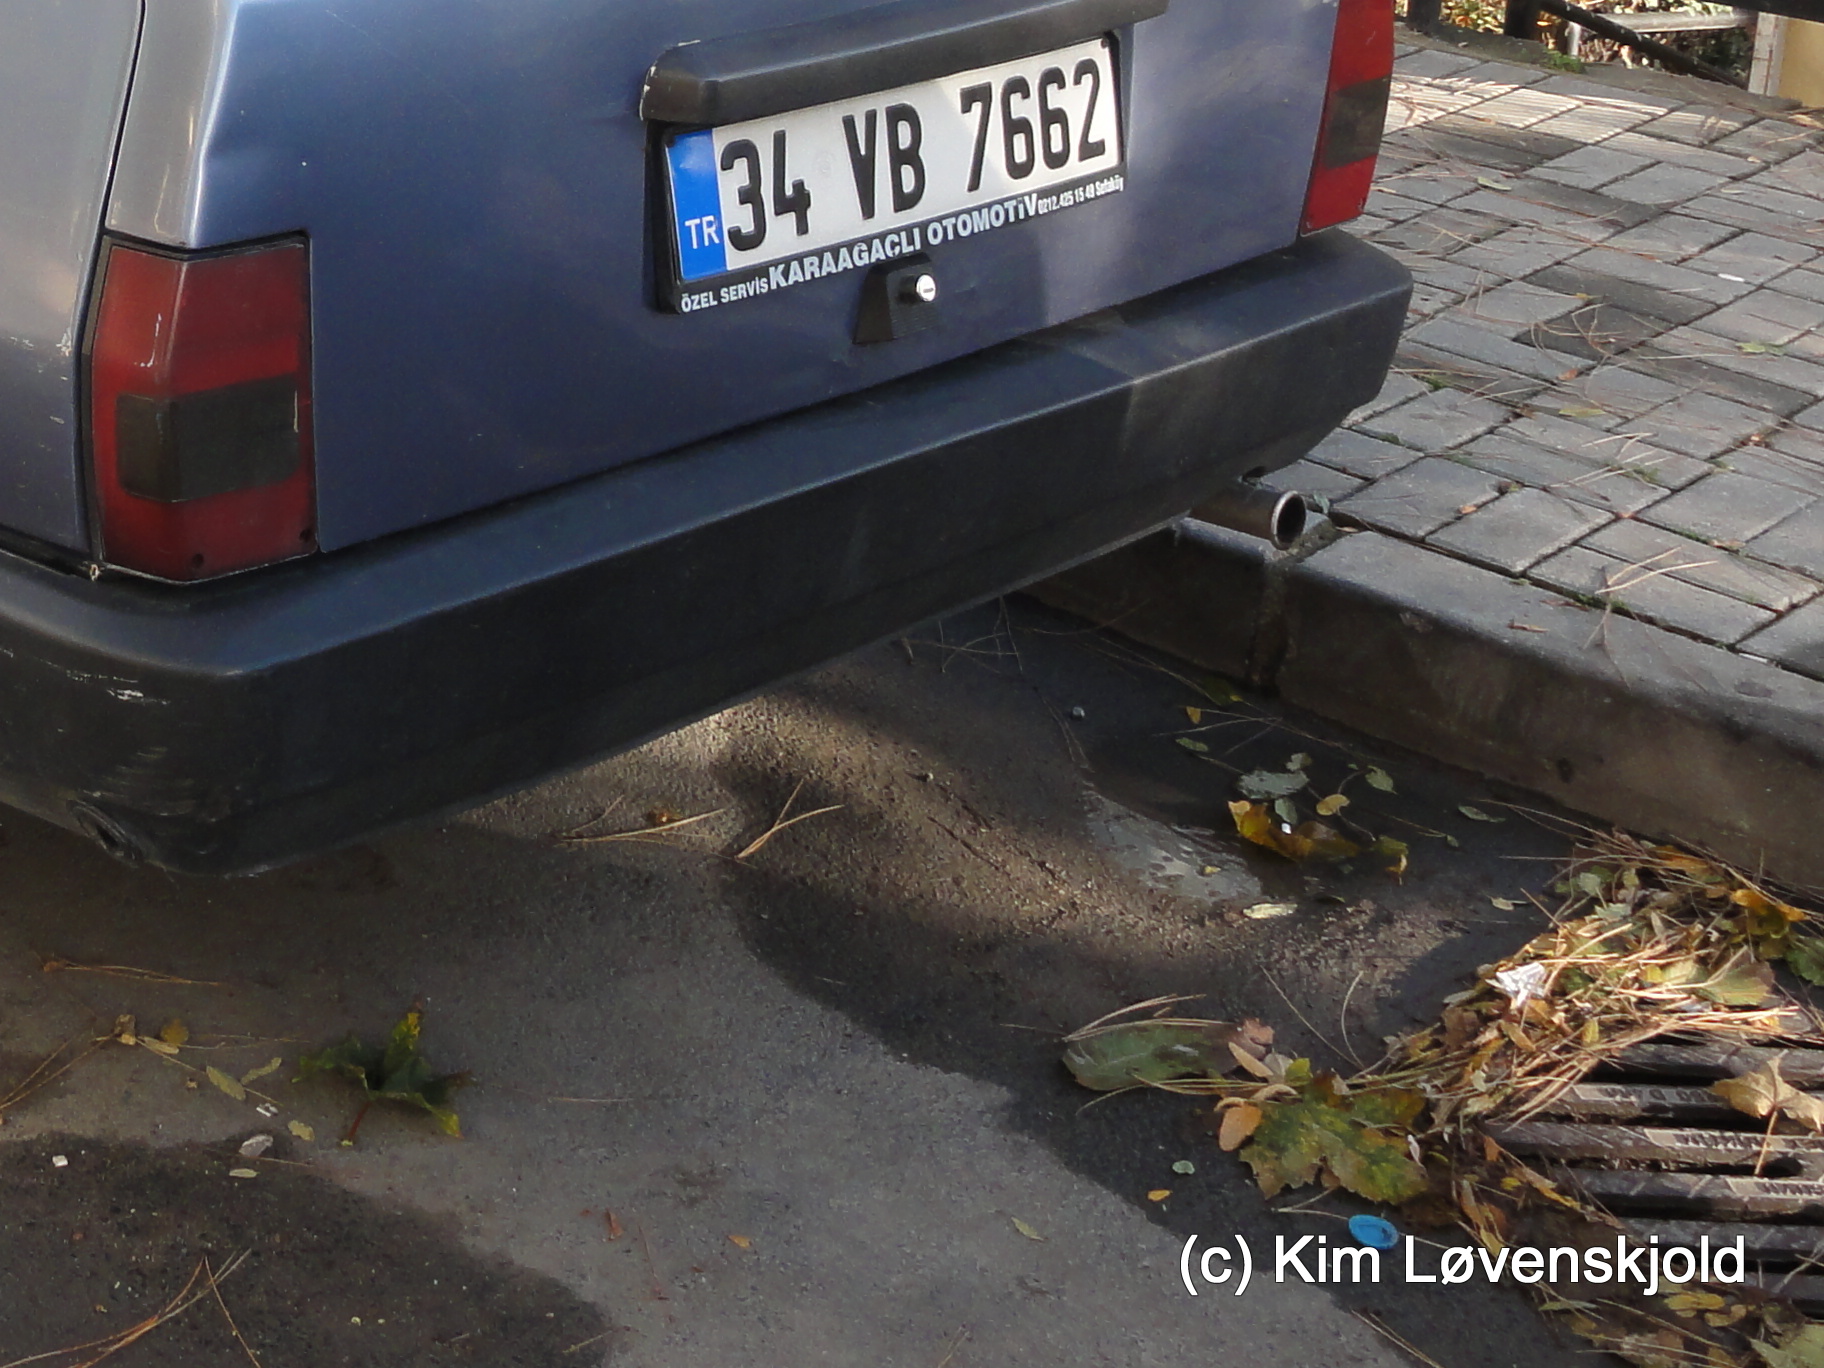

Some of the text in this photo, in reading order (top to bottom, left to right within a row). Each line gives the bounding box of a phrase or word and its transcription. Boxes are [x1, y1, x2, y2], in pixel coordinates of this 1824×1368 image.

[720, 58, 1106, 252] 34 VB 7662
[684, 215, 720, 250] TR
[681, 291, 718, 313] ÖZEL
